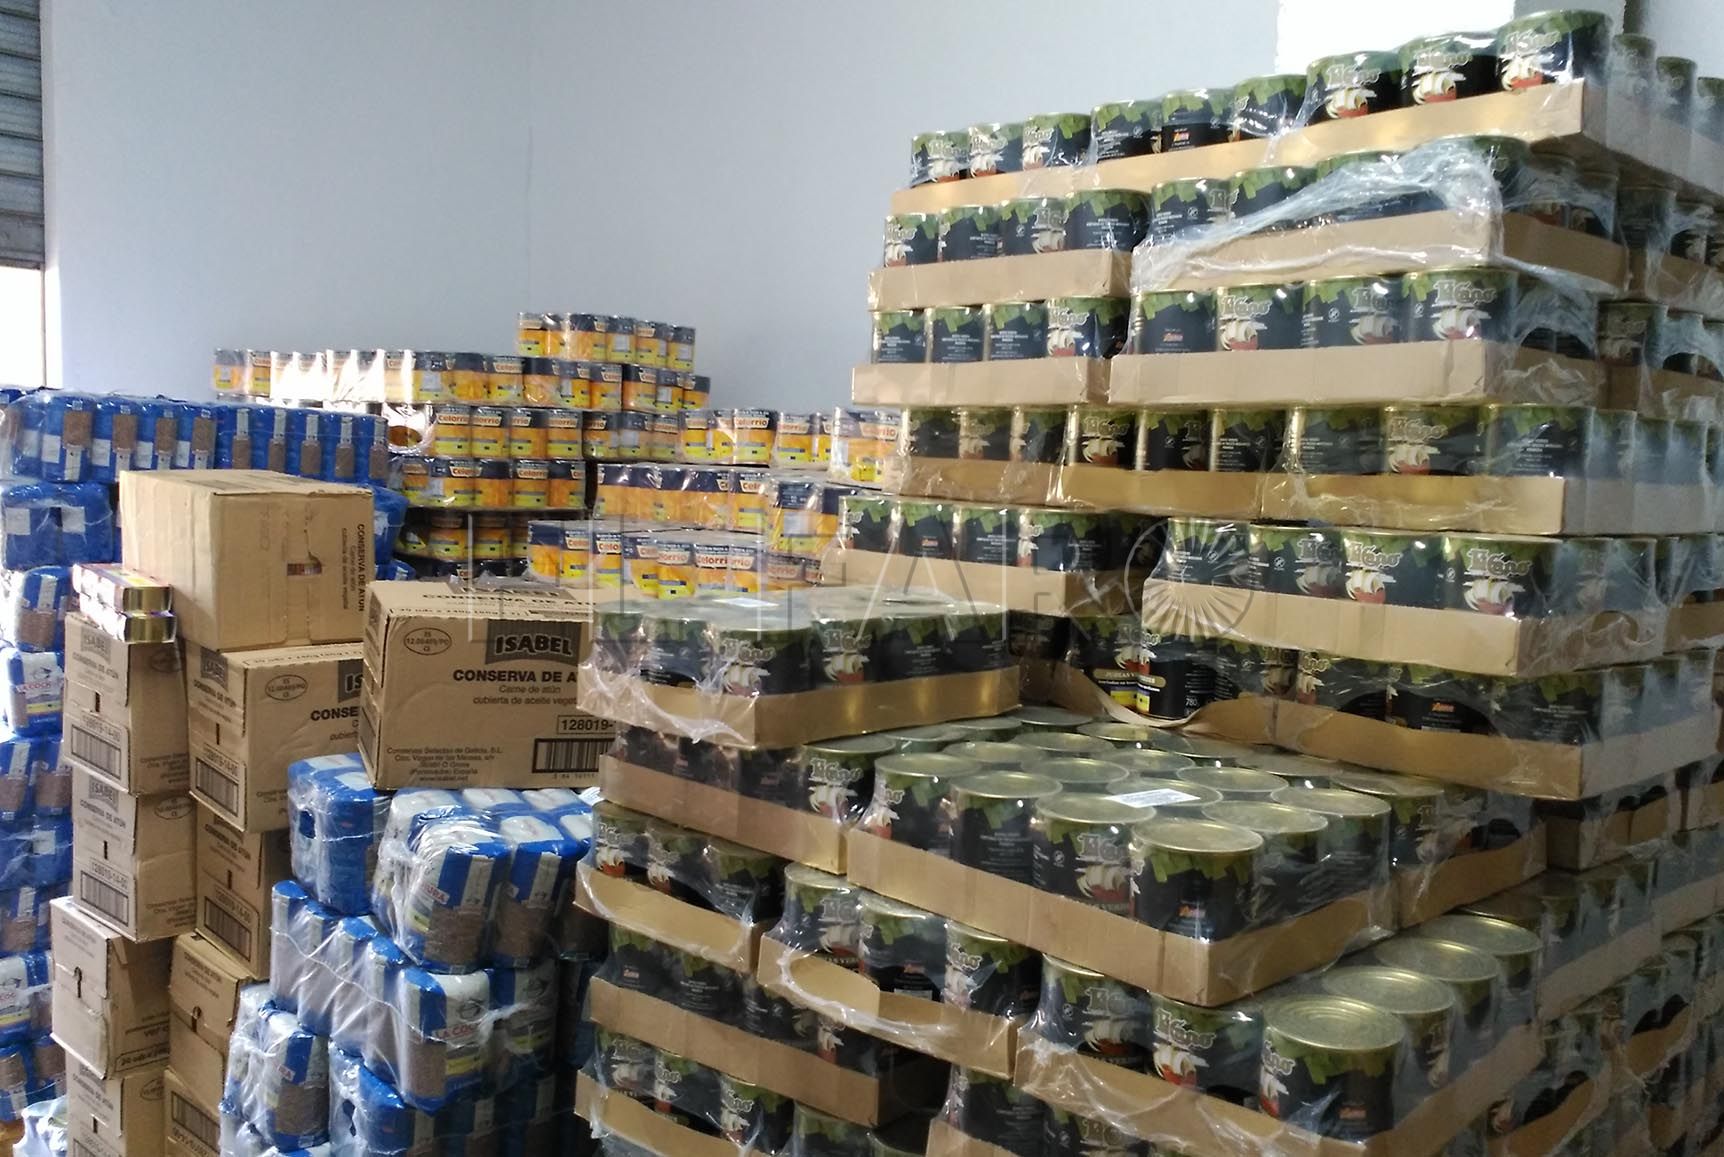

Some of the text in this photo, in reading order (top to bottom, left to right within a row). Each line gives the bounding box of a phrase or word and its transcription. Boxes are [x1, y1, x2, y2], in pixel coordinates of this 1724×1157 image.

[438, 414, 469, 424] Celorri
[519, 469, 546, 478] Celorri
[696, 554, 728, 566] Celorri
[495, 633, 574, 657] ISABEL
[453, 669, 537, 682] CONSERVA
[542, 671, 563, 683] DE
[472, 696, 509, 705] cubierta
[511, 697, 522, 705] de
[524, 697, 551, 705] aceite
[310, 705, 360, 722] CONSE
[562, 719, 617, 731] 128019-
